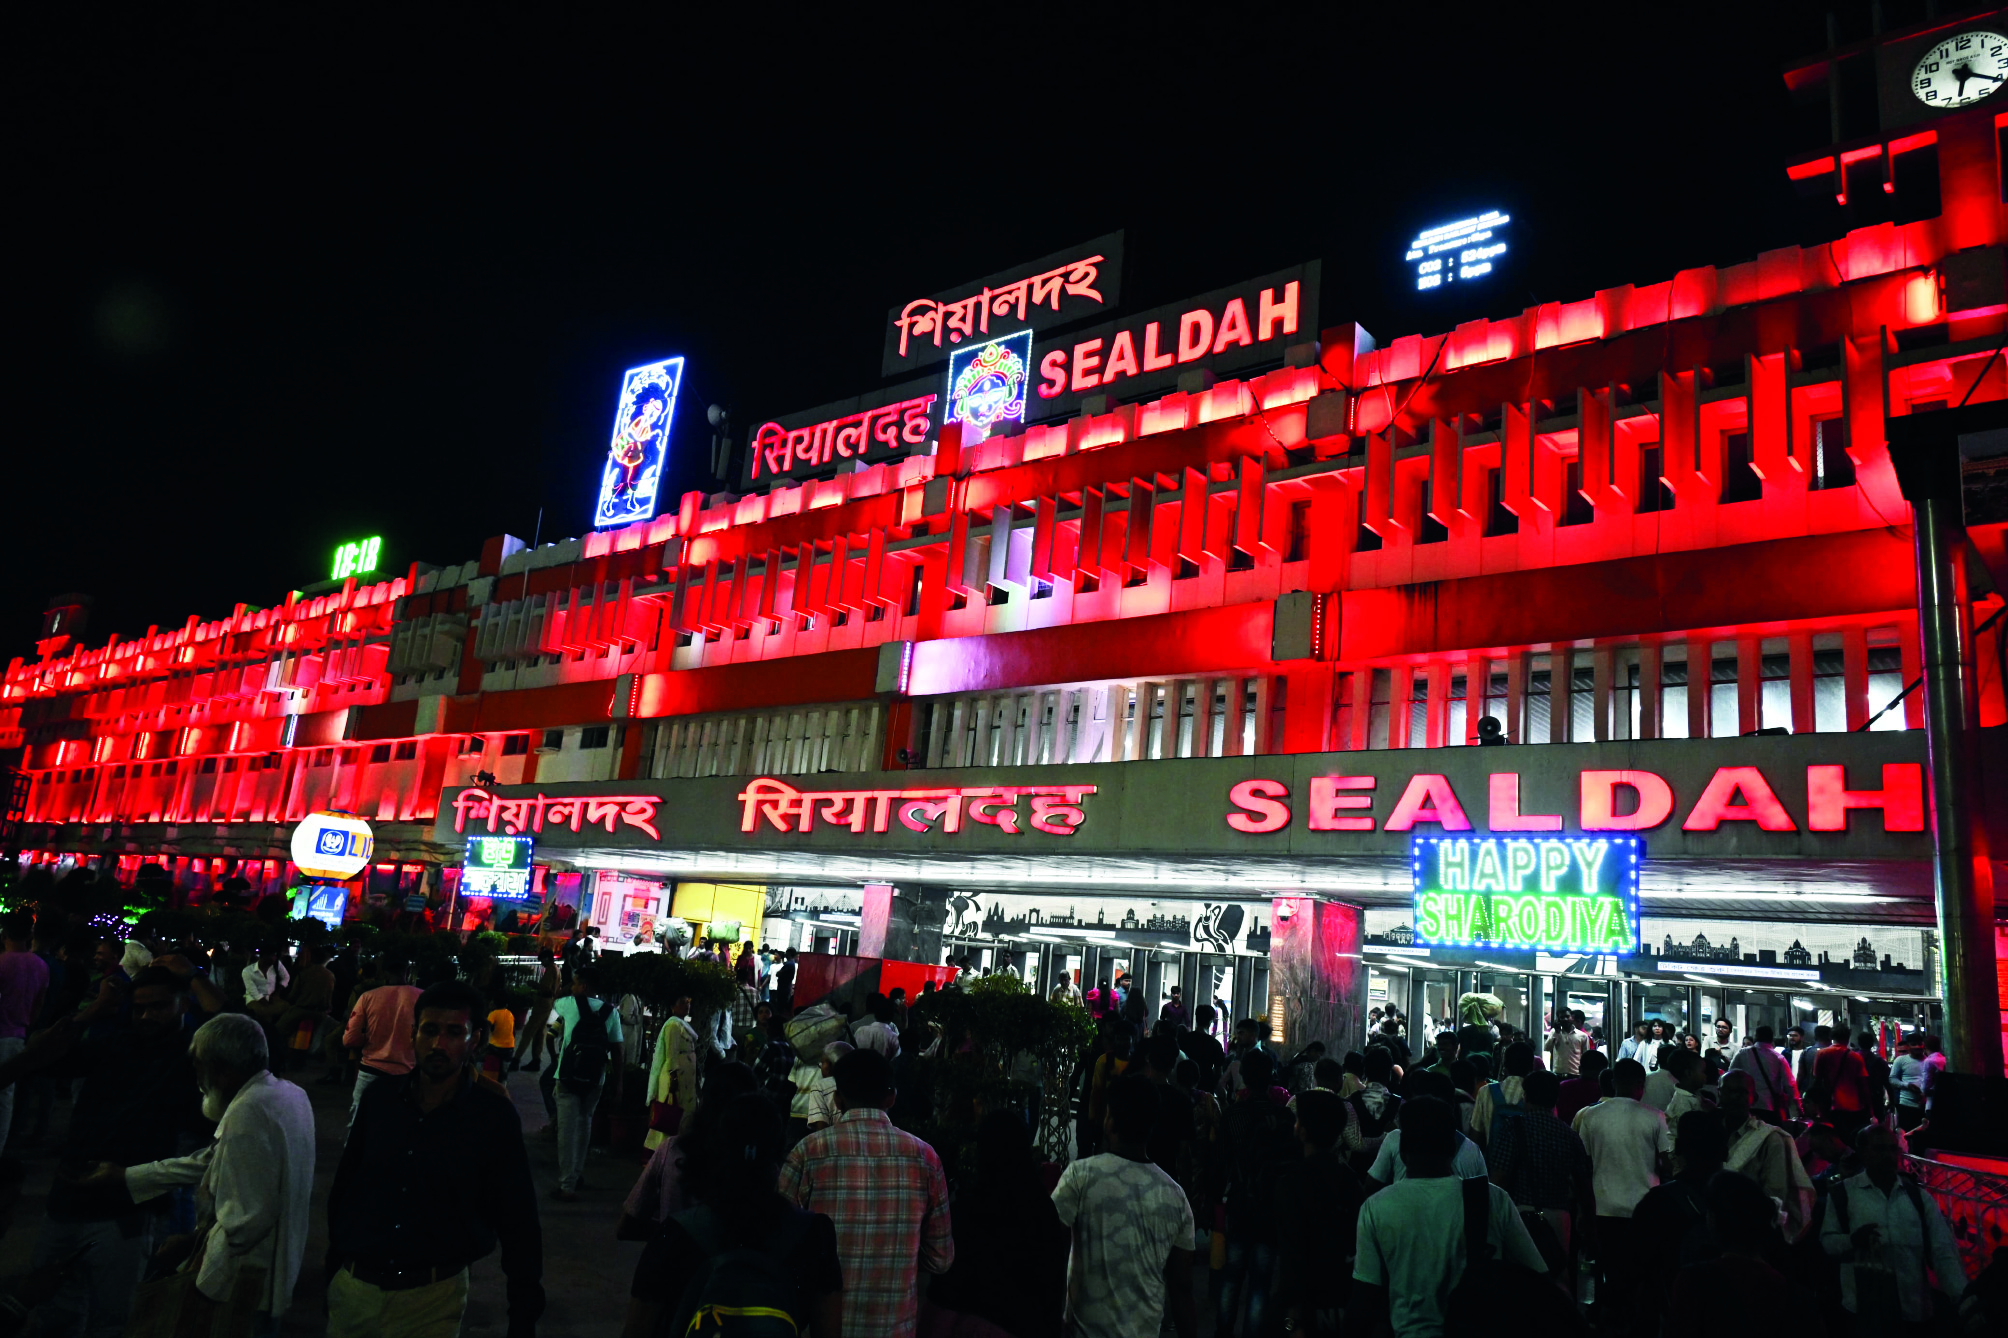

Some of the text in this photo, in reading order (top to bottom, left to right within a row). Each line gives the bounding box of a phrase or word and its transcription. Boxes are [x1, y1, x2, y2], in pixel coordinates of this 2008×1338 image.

[1925, 62, 1939, 74] 10
[1939, 48, 1949, 60] 11
[1955, 38, 1971, 51] 12
[1981, 39, 1985, 48] 1
[1990, 45, 2003, 57] 2
[1920, 78, 1931, 89] 9
[1926, 90, 1938, 101] 8
[893, 254, 1105, 358] শিয়ালদহ
[1037, 280, 1299, 399] SEALDAH
[751, 394, 937, 480] सियालदह
[332, 535, 382, 581] 18:18
[451, 787, 663, 840] শিয়ালদহ
[738, 778, 1098, 835] सियालदह
[1226, 763, 1924, 833] SEALDAH
[1439, 841, 1609, 894] HAPPY
[1419, 891, 1633, 949] SHARODIYA
